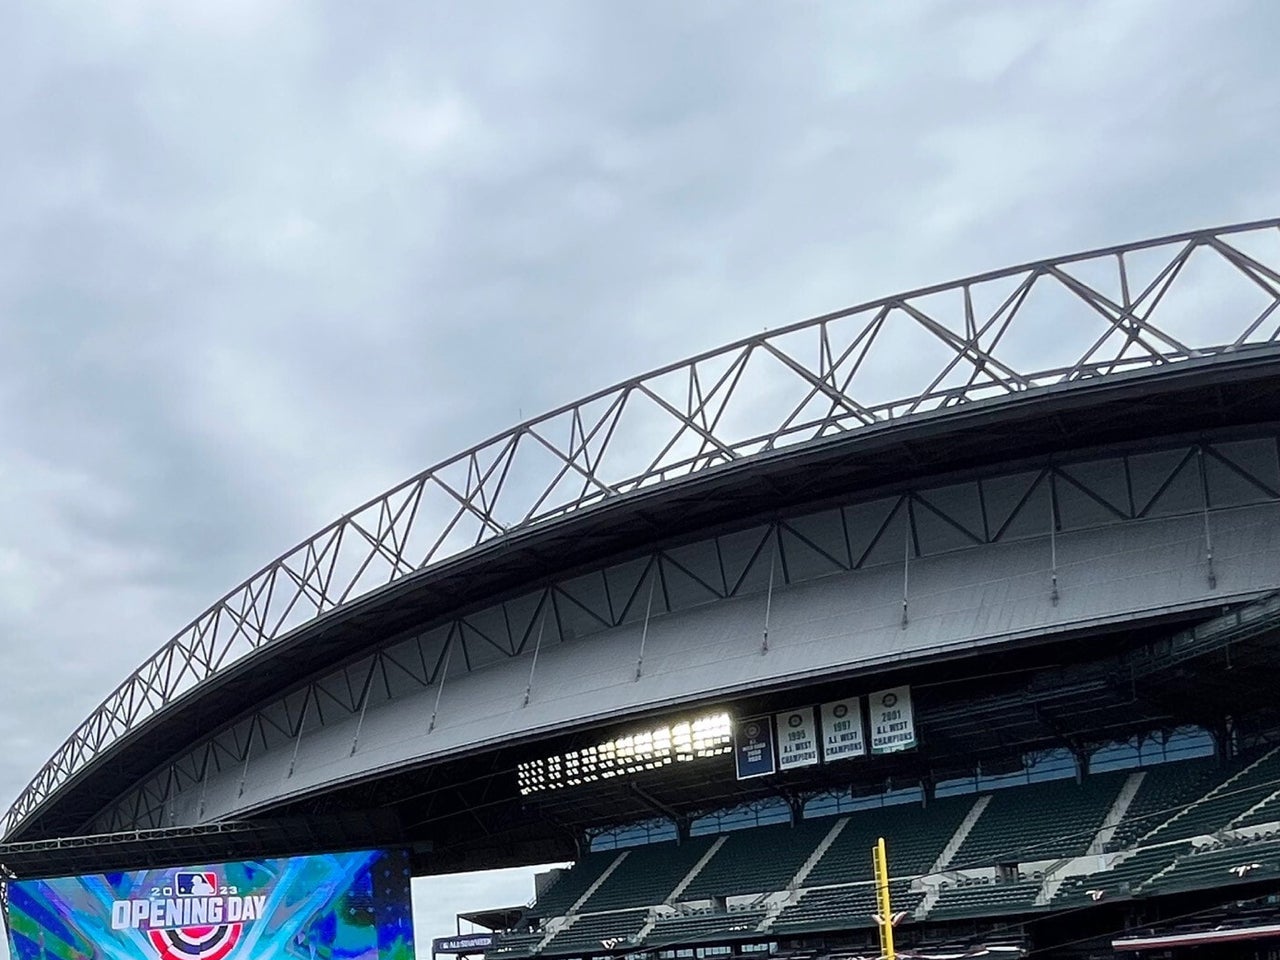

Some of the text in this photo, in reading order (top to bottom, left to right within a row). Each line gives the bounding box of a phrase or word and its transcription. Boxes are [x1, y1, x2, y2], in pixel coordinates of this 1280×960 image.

[889, 721, 908, 732] WEST
[840, 732, 858, 743] WEST
[874, 732, 913, 746] CHAMPIONS
[795, 741, 812, 750] WEST
[826, 742, 862, 756] CHAMPIONS
[781, 751, 816, 764] CHAMPIONS
[151, 886, 238, 896] 20 23
[112, 895, 266, 930] OPENING DAY
